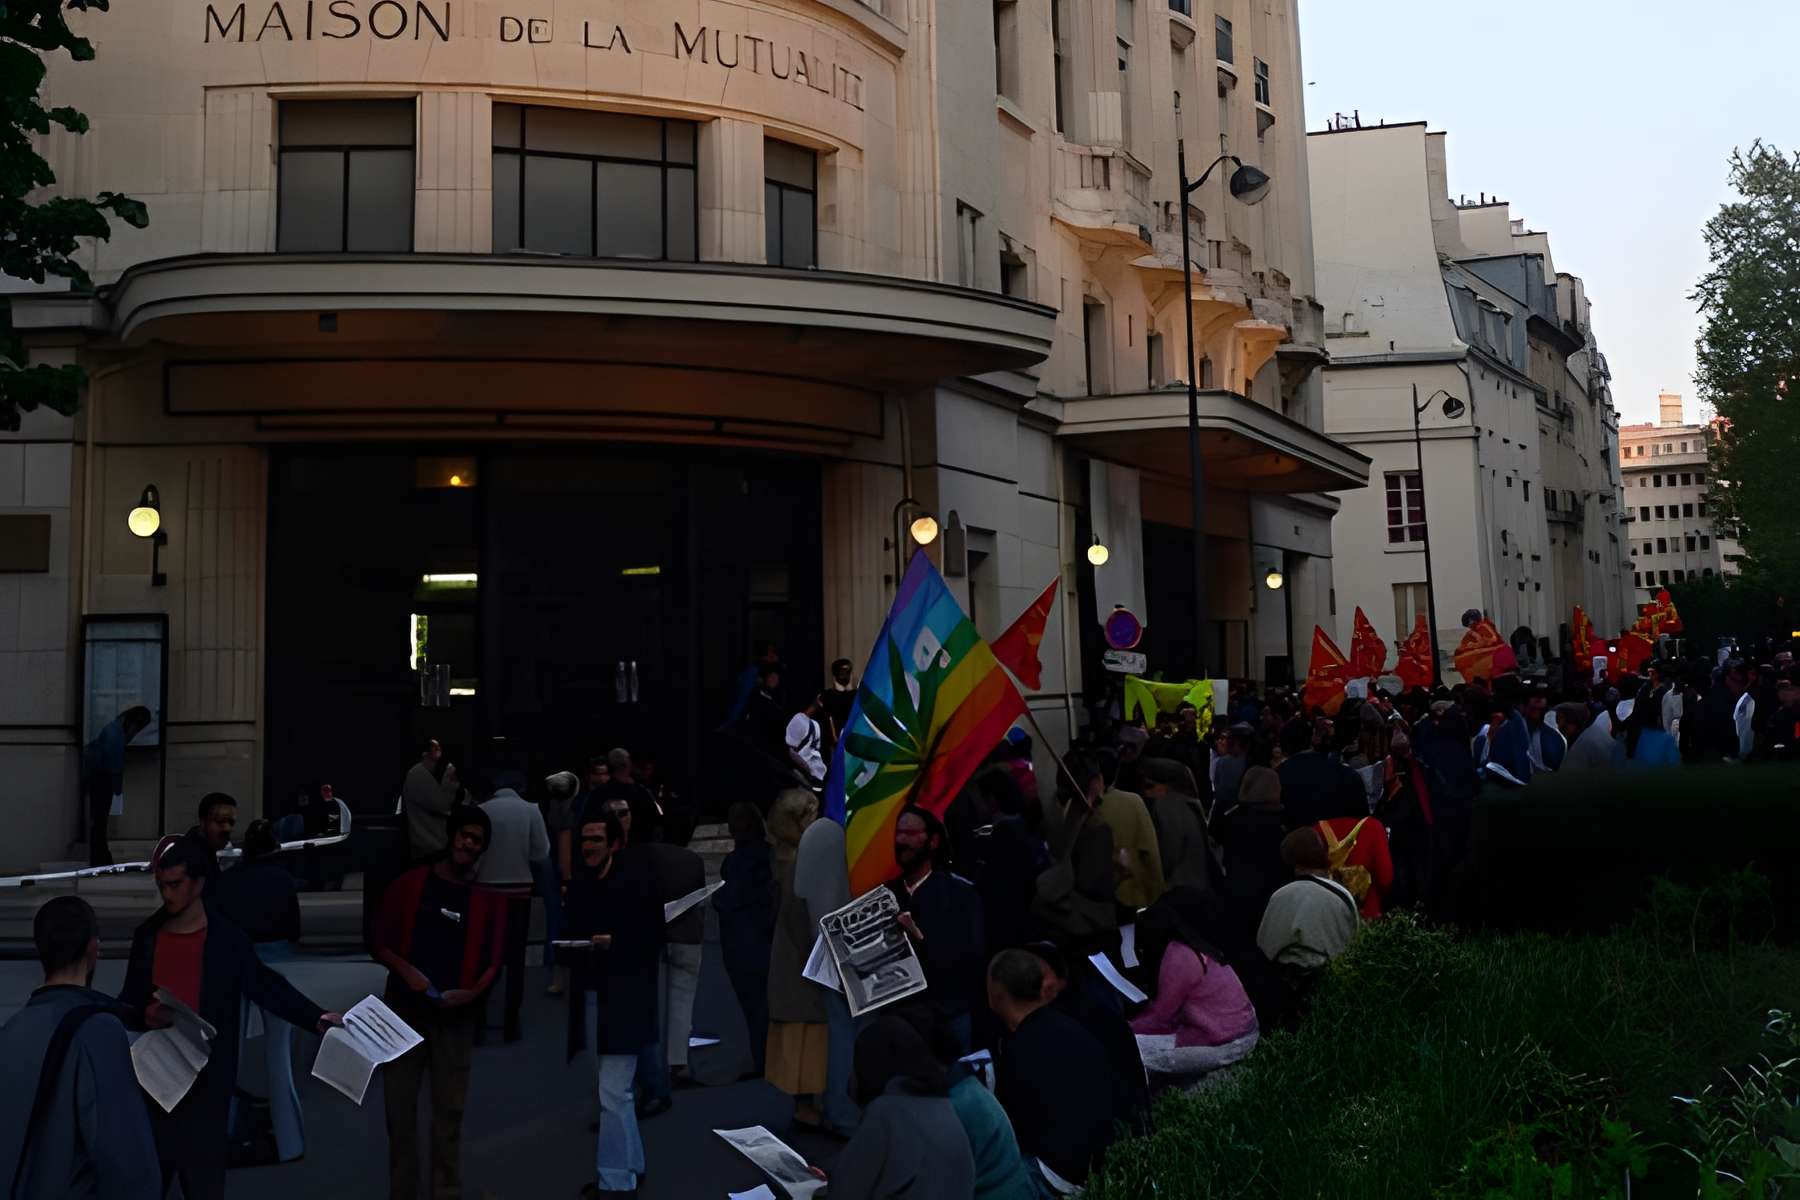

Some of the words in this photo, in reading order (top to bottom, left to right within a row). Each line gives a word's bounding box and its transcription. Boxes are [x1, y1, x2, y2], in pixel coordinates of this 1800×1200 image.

[204, 0, 451, 43] MAISON
[500, 16, 552, 43] DE
[584, 20, 632, 54] LA
